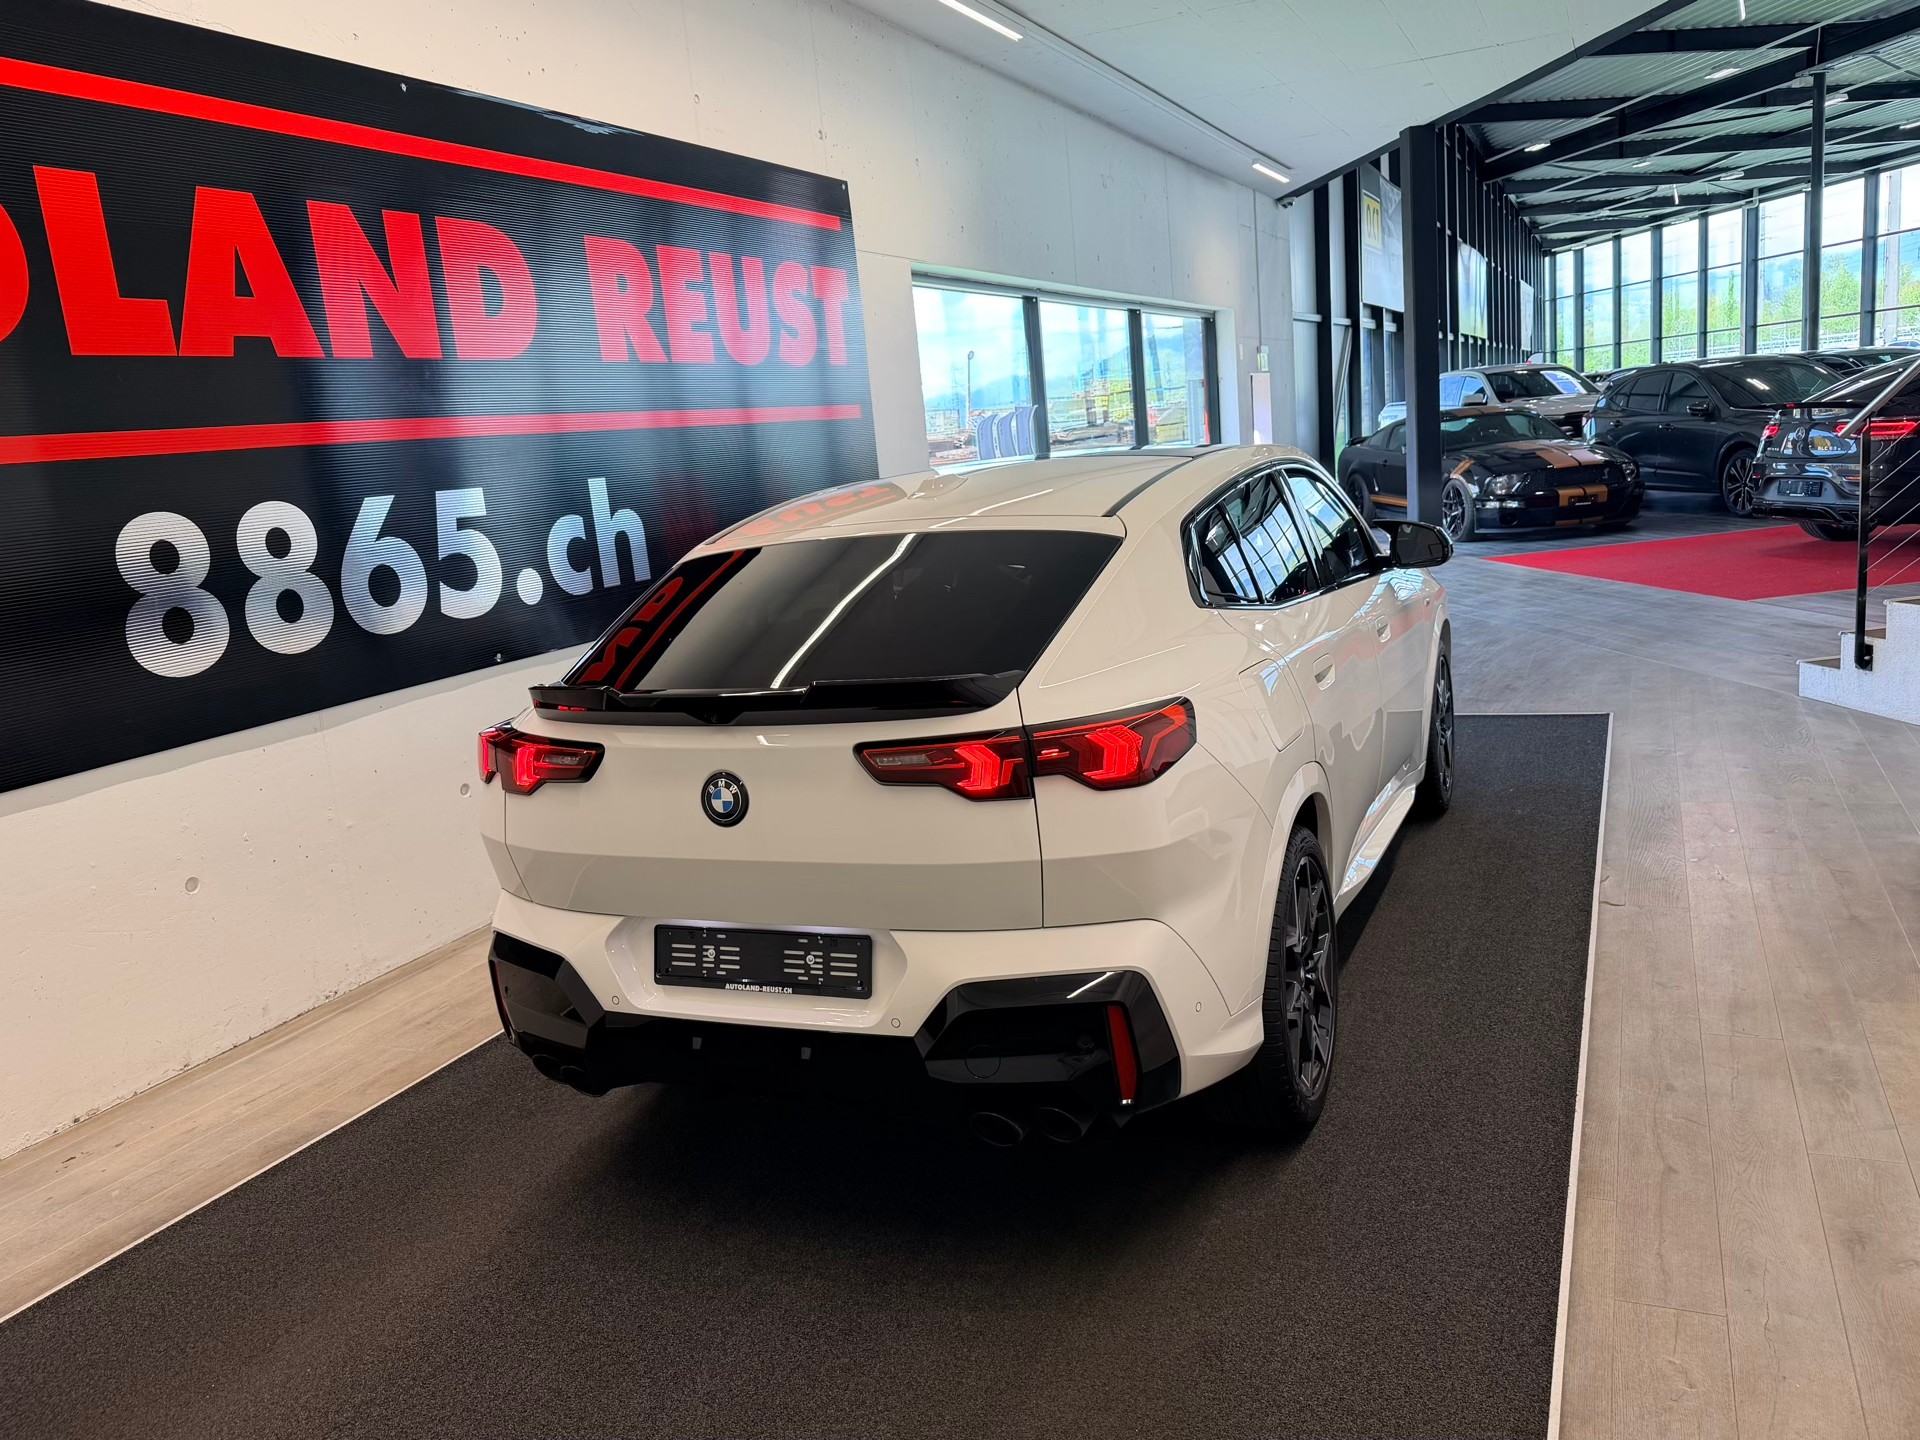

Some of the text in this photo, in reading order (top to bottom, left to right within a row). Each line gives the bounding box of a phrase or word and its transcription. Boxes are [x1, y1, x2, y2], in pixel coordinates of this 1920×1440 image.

[0, 165, 849, 367] LAND REUST
[115, 477, 651, 678] 8865.ch
[708, 780, 738, 794] BMW
[725, 983, 793, 994] AUTOLAND-REUST.CH
